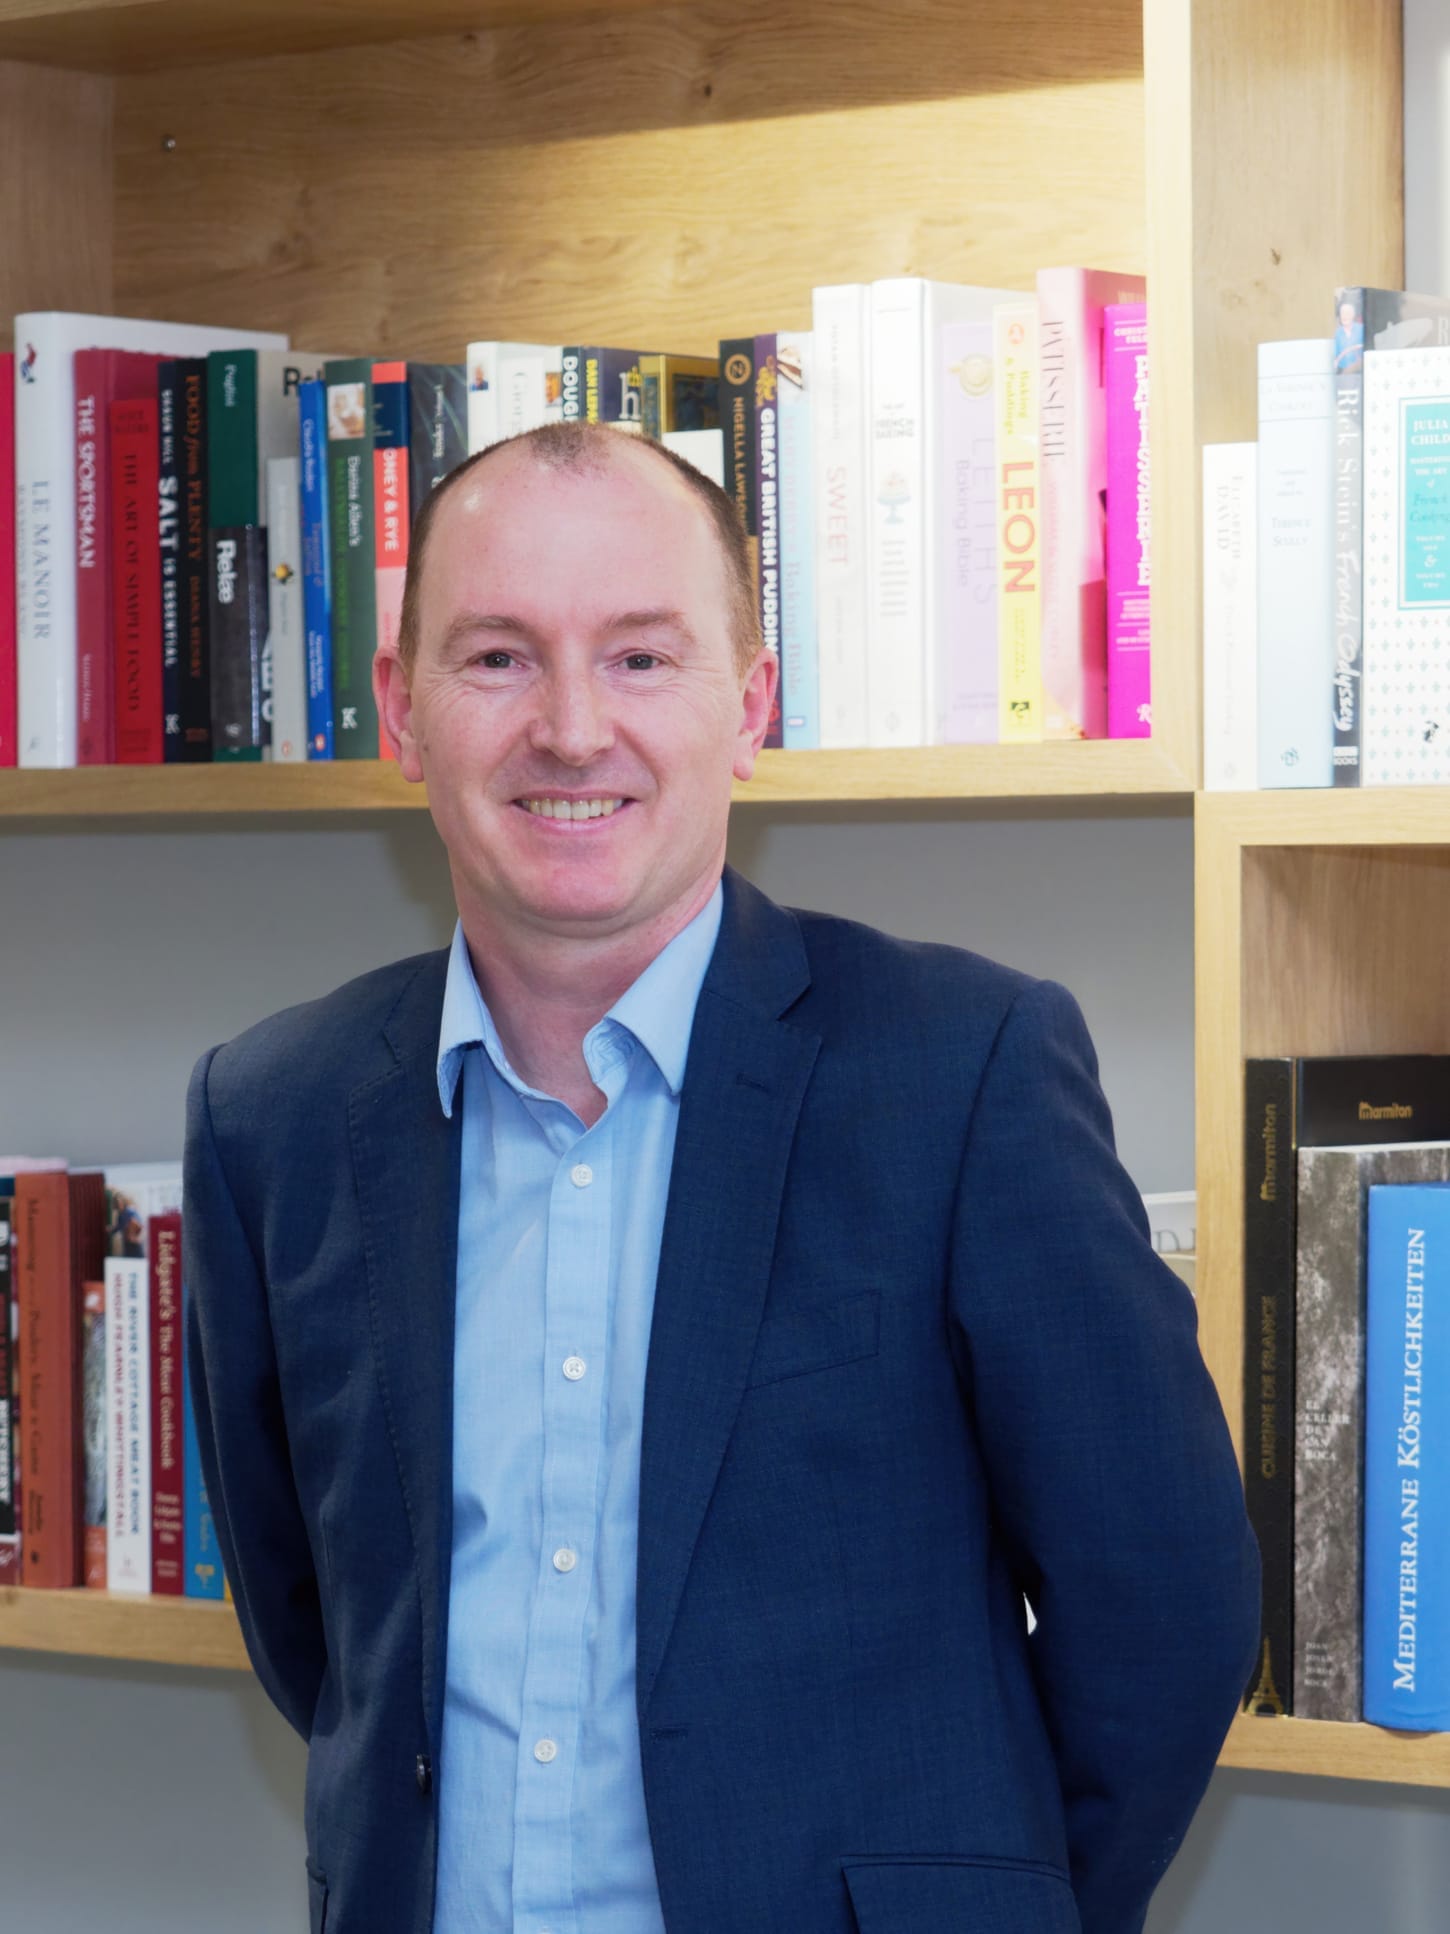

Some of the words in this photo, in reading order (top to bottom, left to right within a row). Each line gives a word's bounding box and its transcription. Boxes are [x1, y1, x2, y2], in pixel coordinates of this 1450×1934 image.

[586, 359, 598, 387] DAN
[1041, 320, 1065, 462] PATISSERIE
[77, 396, 95, 437] THE
[184, 375, 201, 435] FOOD
[731, 396, 747, 459] NIGELLA
[1336, 388, 1360, 447] Rick
[1412, 419, 1448, 432] JULIA
[301, 420, 316, 458] Claudia
[759, 407, 775, 480] GREAT
[32, 481, 50, 513] LE
[77, 442, 97, 568] SPORTSMAN
[304, 459, 316, 492] Roden
[348, 456, 361, 499] Darina
[953, 459, 972, 531] Baking
[1336, 457, 1360, 543] Stein's
[124, 497, 138, 533] ART
[158, 475, 179, 551] SALT
[186, 480, 202, 561] PLENTY
[348, 502, 363, 547] Allen's
[384, 501, 397, 513] &
[384, 516, 399, 551] RYE
[760, 485, 777, 565] BRITISH
[826, 466, 849, 570] SWEET
[1001, 461, 1036, 594] LEON
[1216, 486, 1231, 550] DAVID
[32, 524, 51, 638] MANOIR
[126, 541, 139, 566] OF
[957, 537, 973, 588] Bible
[126, 571, 140, 642] SIMPLE
[1334, 551, 1360, 628] French
[163, 580, 177, 668] ESSENTIAL
[127, 648, 141, 713] FOOD
[1333, 633, 1361, 732] Odyssey
[1358, 1101, 1413, 1121] marmiton
[128, 1272, 140, 1301] THE
[156, 1230, 178, 1320] Lidgate's
[128, 1304, 140, 1355] RIVER
[159, 1323, 175, 1353] The
[1261, 1296, 1276, 1373] FRANCE
[1398, 1228, 1426, 1467] KÖSTLICHKEITEN
[128, 1358, 140, 1434] COTTAGE
[159, 1356, 175, 1393] Meat
[1261, 1378, 1276, 1402] DE
[159, 1396, 177, 1470] Cookbook
[1304, 1413, 1351, 1425] CELLER
[128, 1438, 141, 1485] MEAT
[1304, 1449, 1336, 1461] ROCA
[128, 1487, 142, 1537] BOOK
[1394, 1478, 1420, 1692] MEDITERRANE
[1304, 1678, 1328, 1688] ROCA
